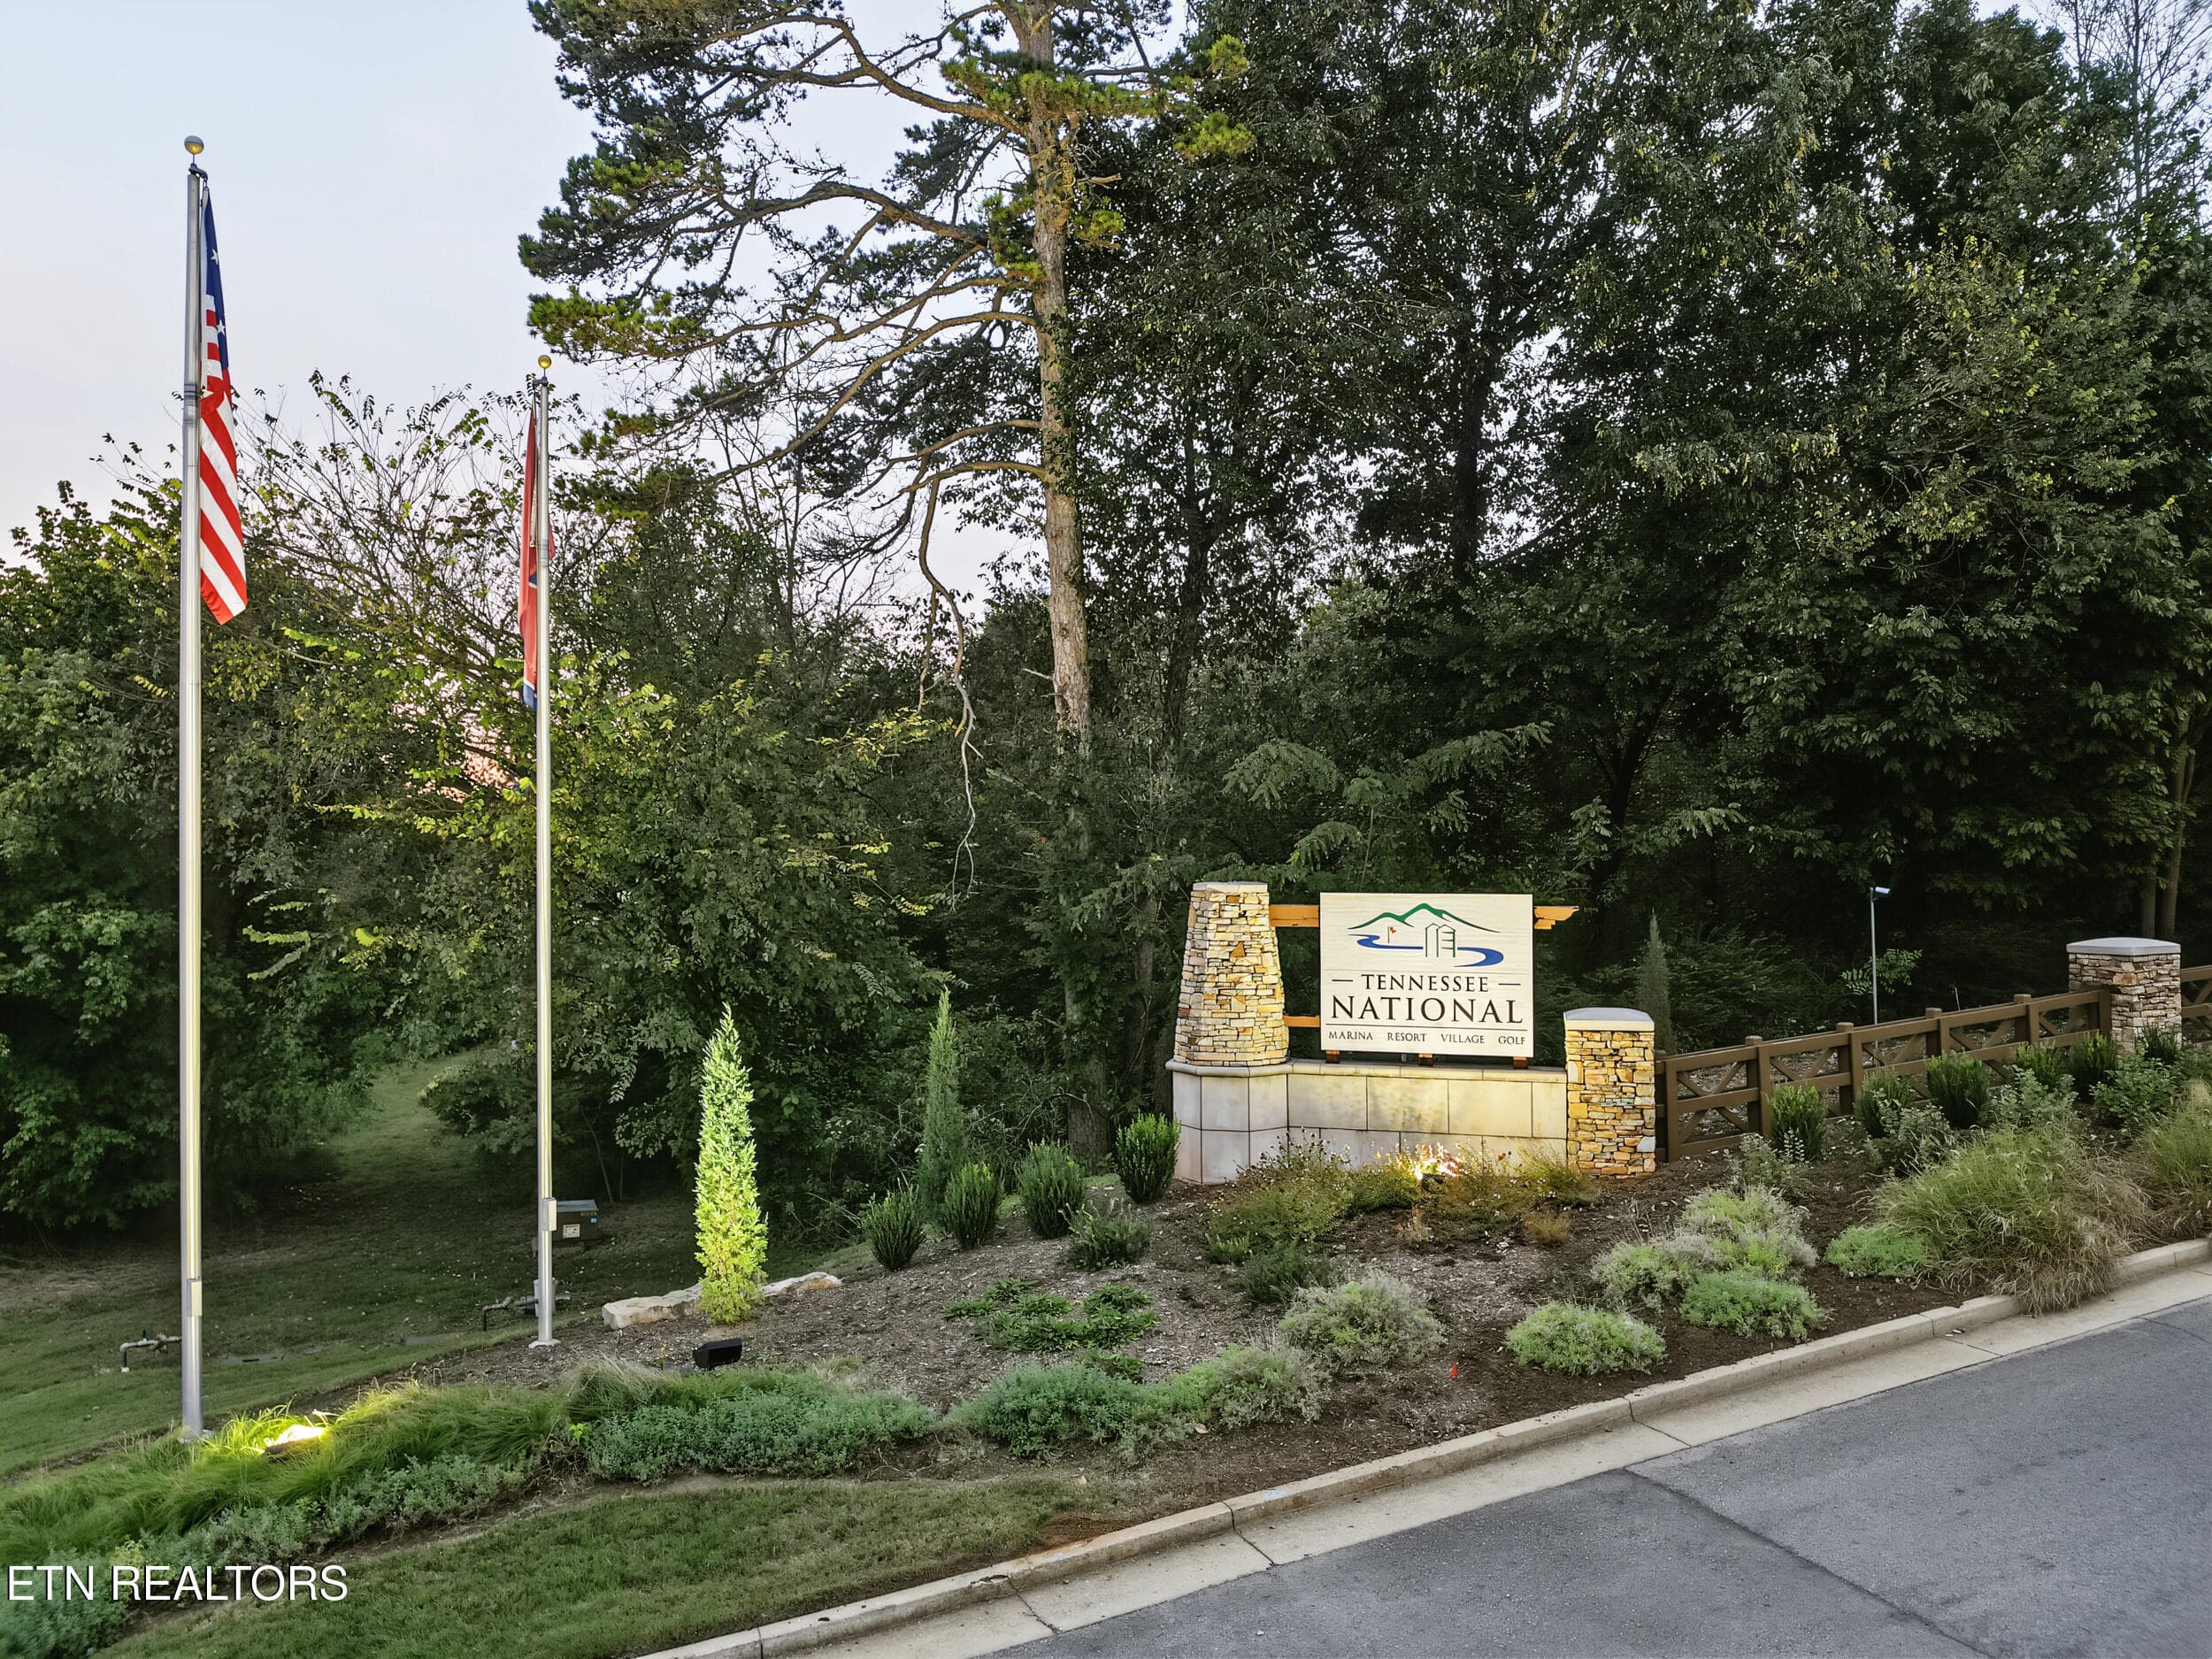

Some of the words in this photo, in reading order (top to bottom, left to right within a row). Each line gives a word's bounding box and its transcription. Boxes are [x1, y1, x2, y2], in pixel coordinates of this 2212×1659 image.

[1361, 974, 1489, 992] TENNESSEE
[1331, 995, 1523, 1024] NATIONAL
[1328, 1031, 1373, 1041] MARINA
[1387, 1032, 1427, 1042] RESORT
[1440, 1033, 1486, 1044] VILLAGE
[1498, 1035, 1526, 1045] GOLF
